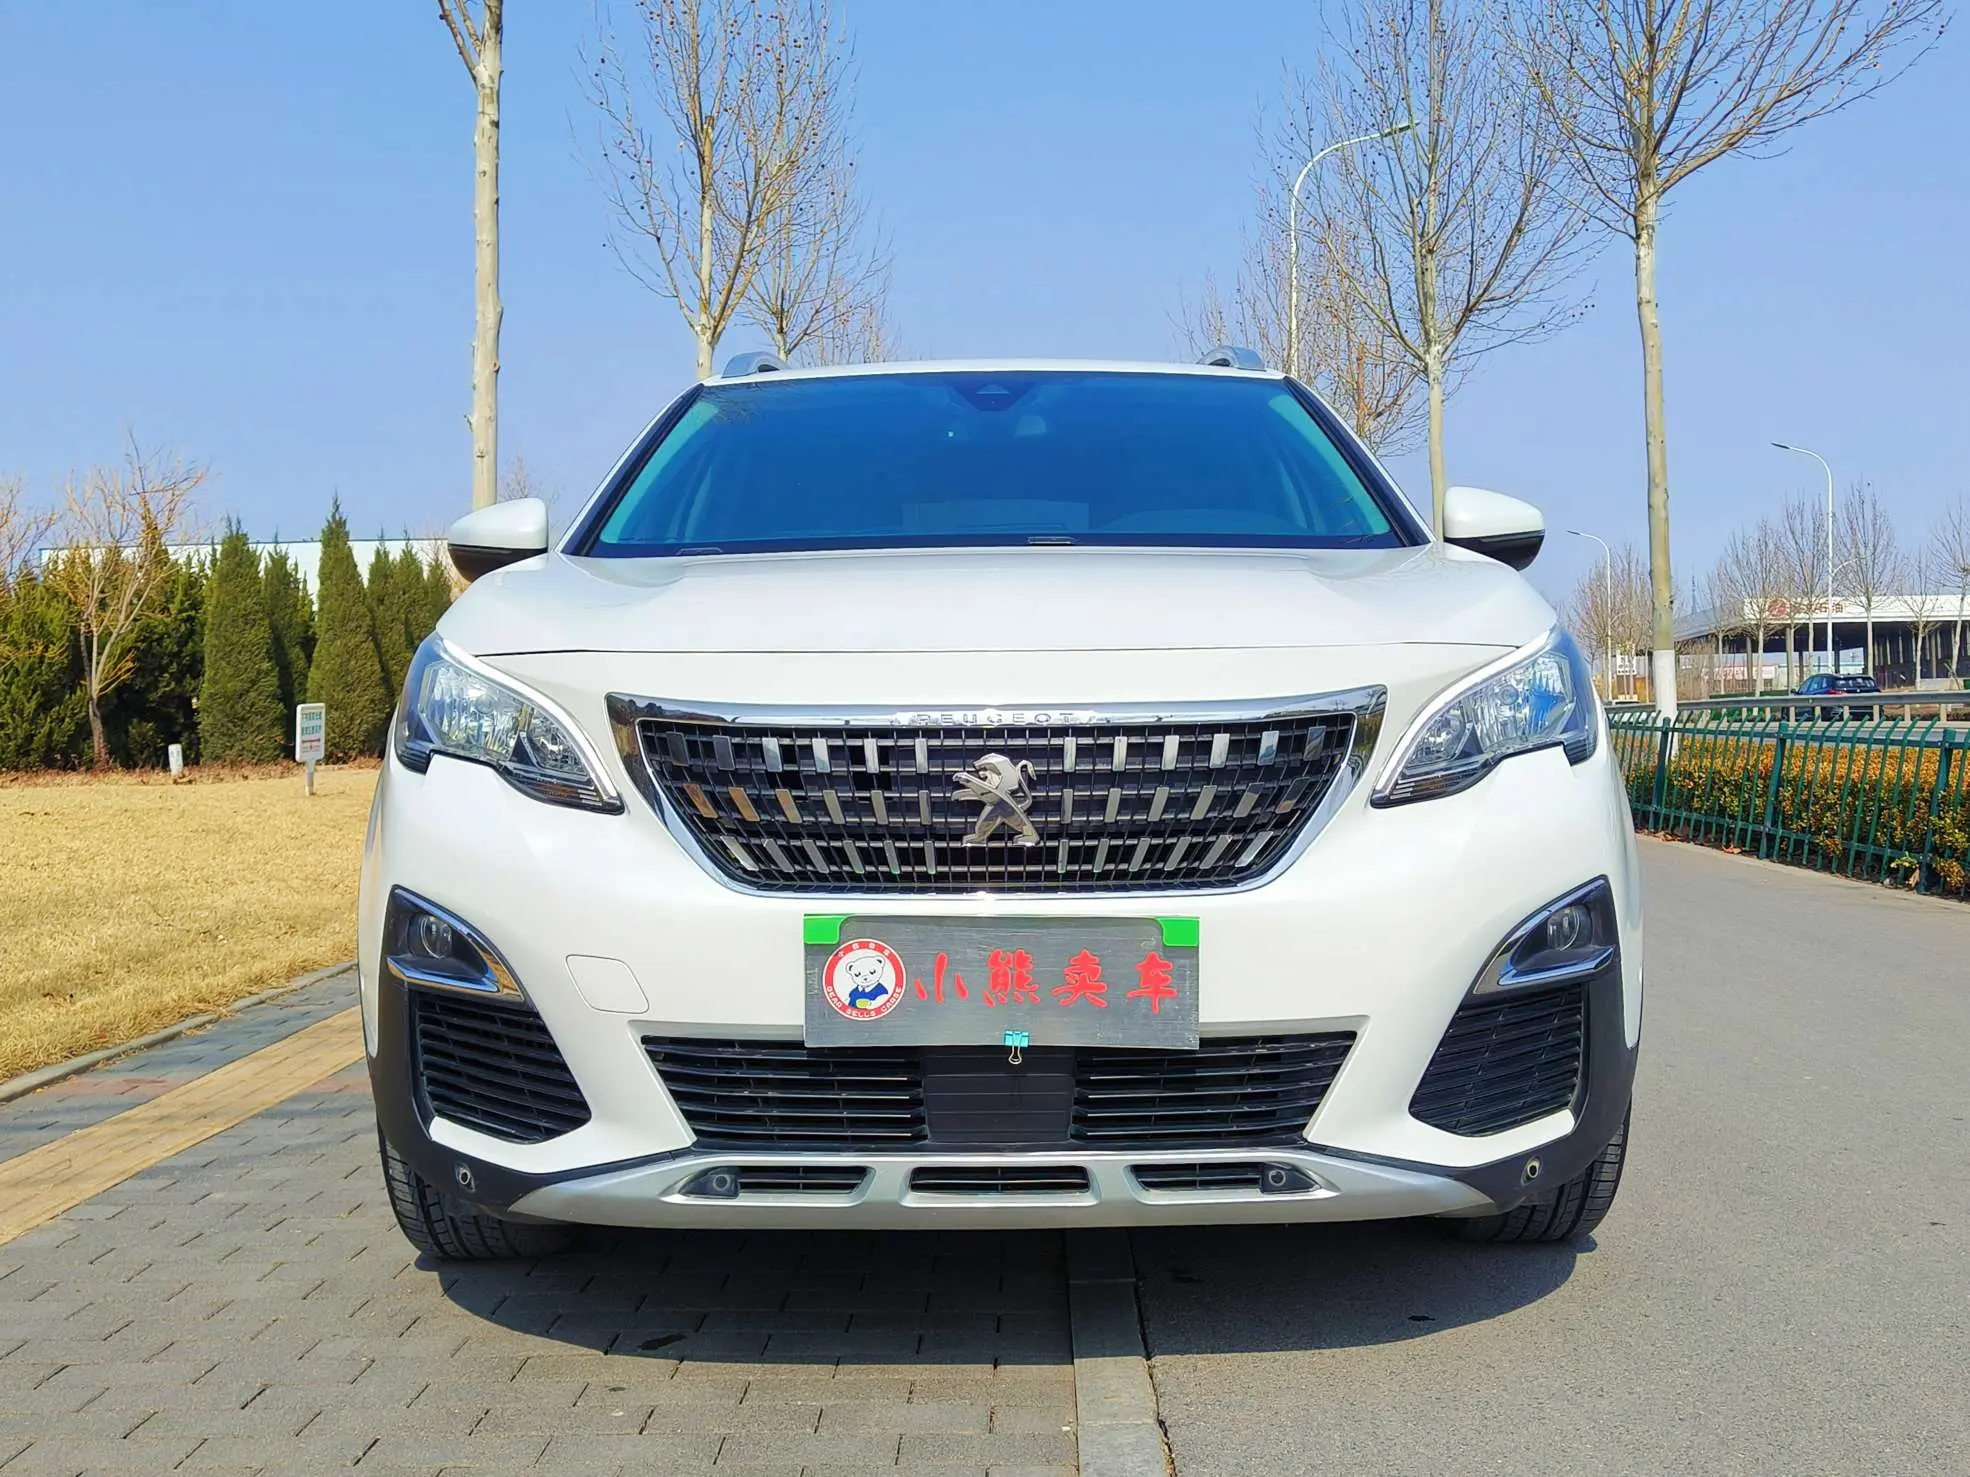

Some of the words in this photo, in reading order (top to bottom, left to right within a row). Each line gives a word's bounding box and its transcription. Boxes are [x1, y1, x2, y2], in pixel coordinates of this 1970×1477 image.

[916, 712, 1074, 725] PEUGEOT
[913, 948, 1177, 1014] 小熊卖车
